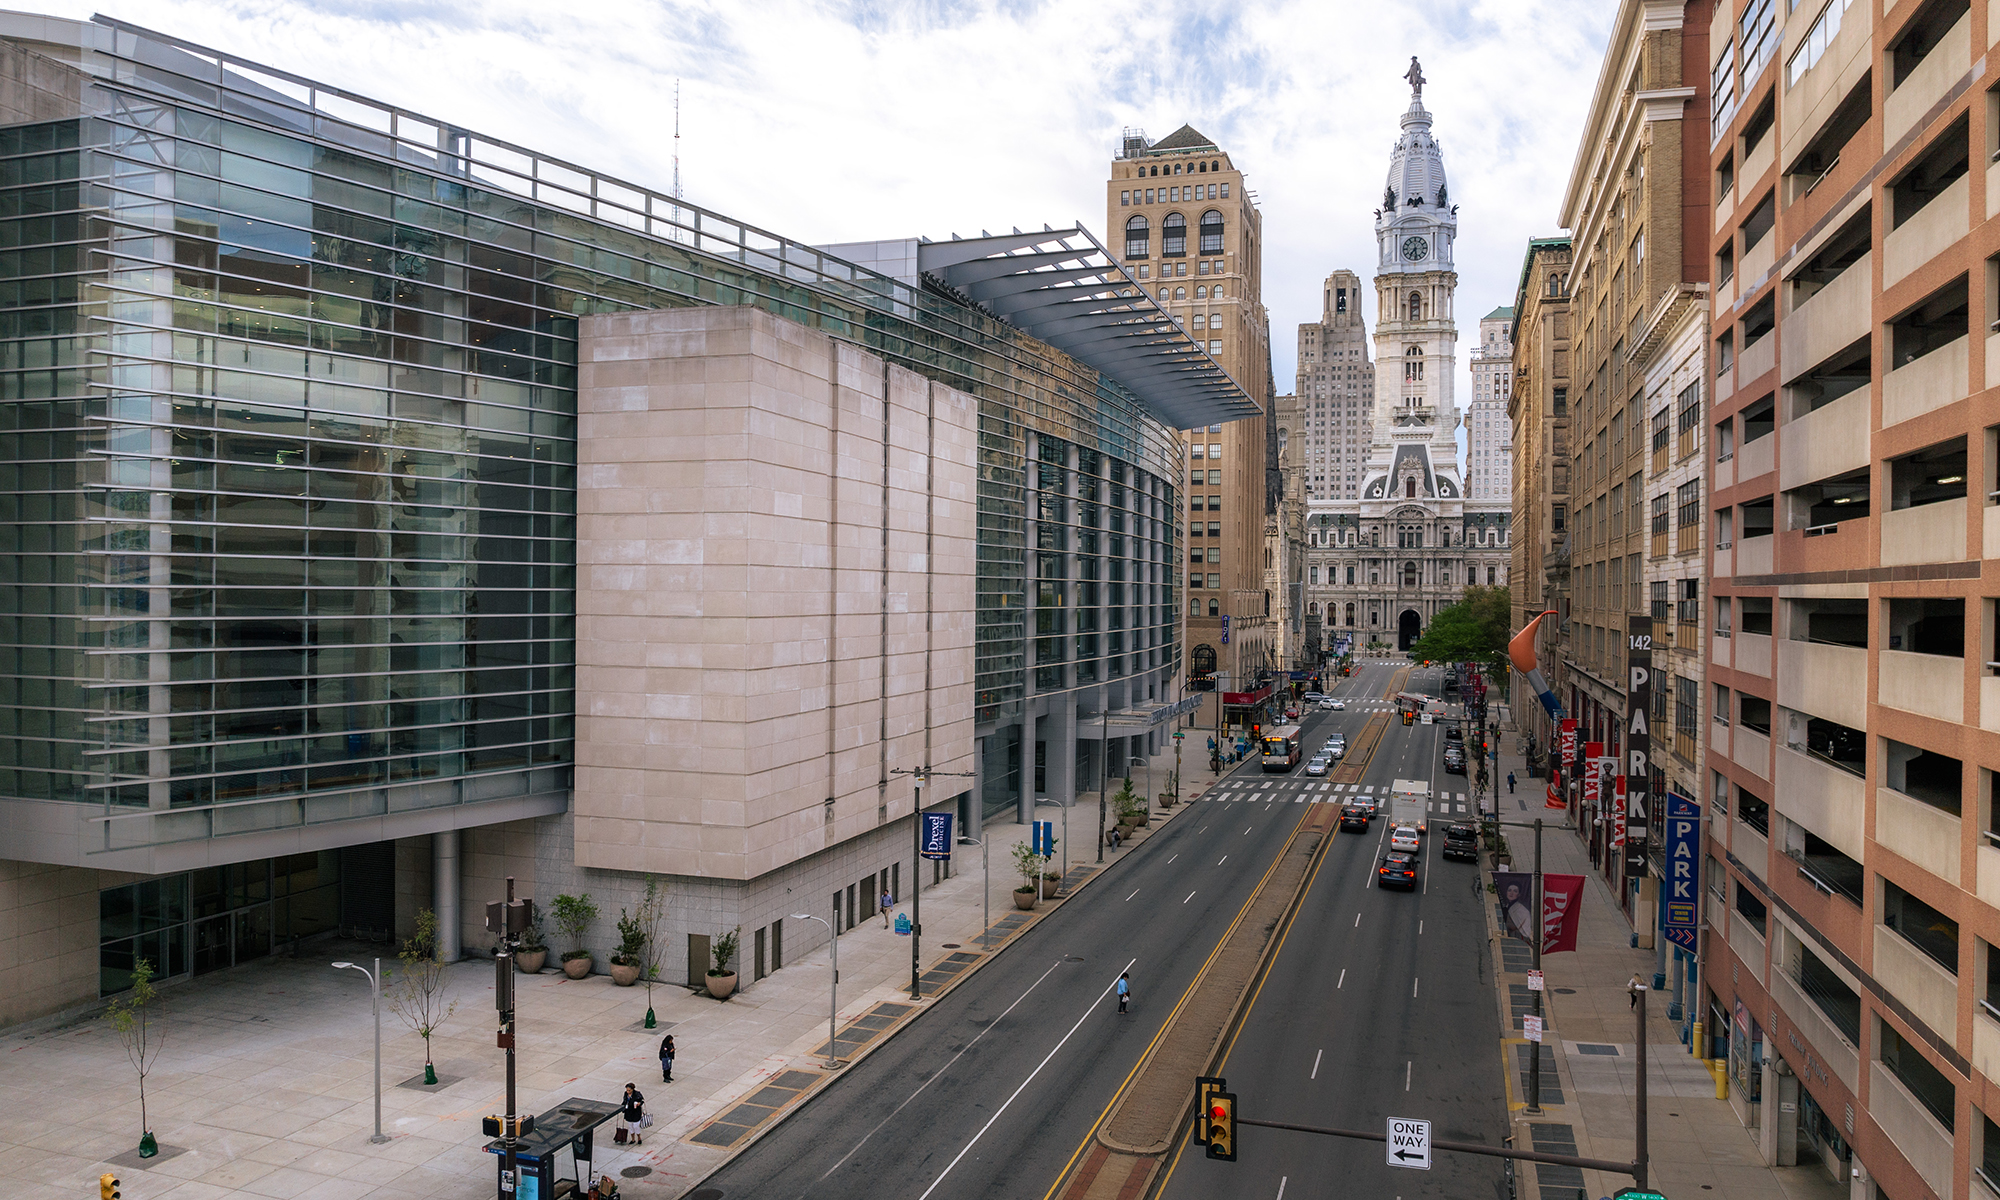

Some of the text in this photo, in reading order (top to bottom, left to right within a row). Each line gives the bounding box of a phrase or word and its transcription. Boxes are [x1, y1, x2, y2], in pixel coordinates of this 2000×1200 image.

[1629, 635, 1651, 650] 142
[1562, 731, 1574, 764] PAFA
[1629, 667, 1649, 818] PARK
[1585, 757, 1599, 797] PAFA
[928, 816, 940, 851] Drexel
[1674, 821, 1692, 898] PARK
[1543, 890, 1568, 954] PAFA
[1394, 1122, 1424, 1135] ONE
[1394, 1135, 1423, 1147] WAY
